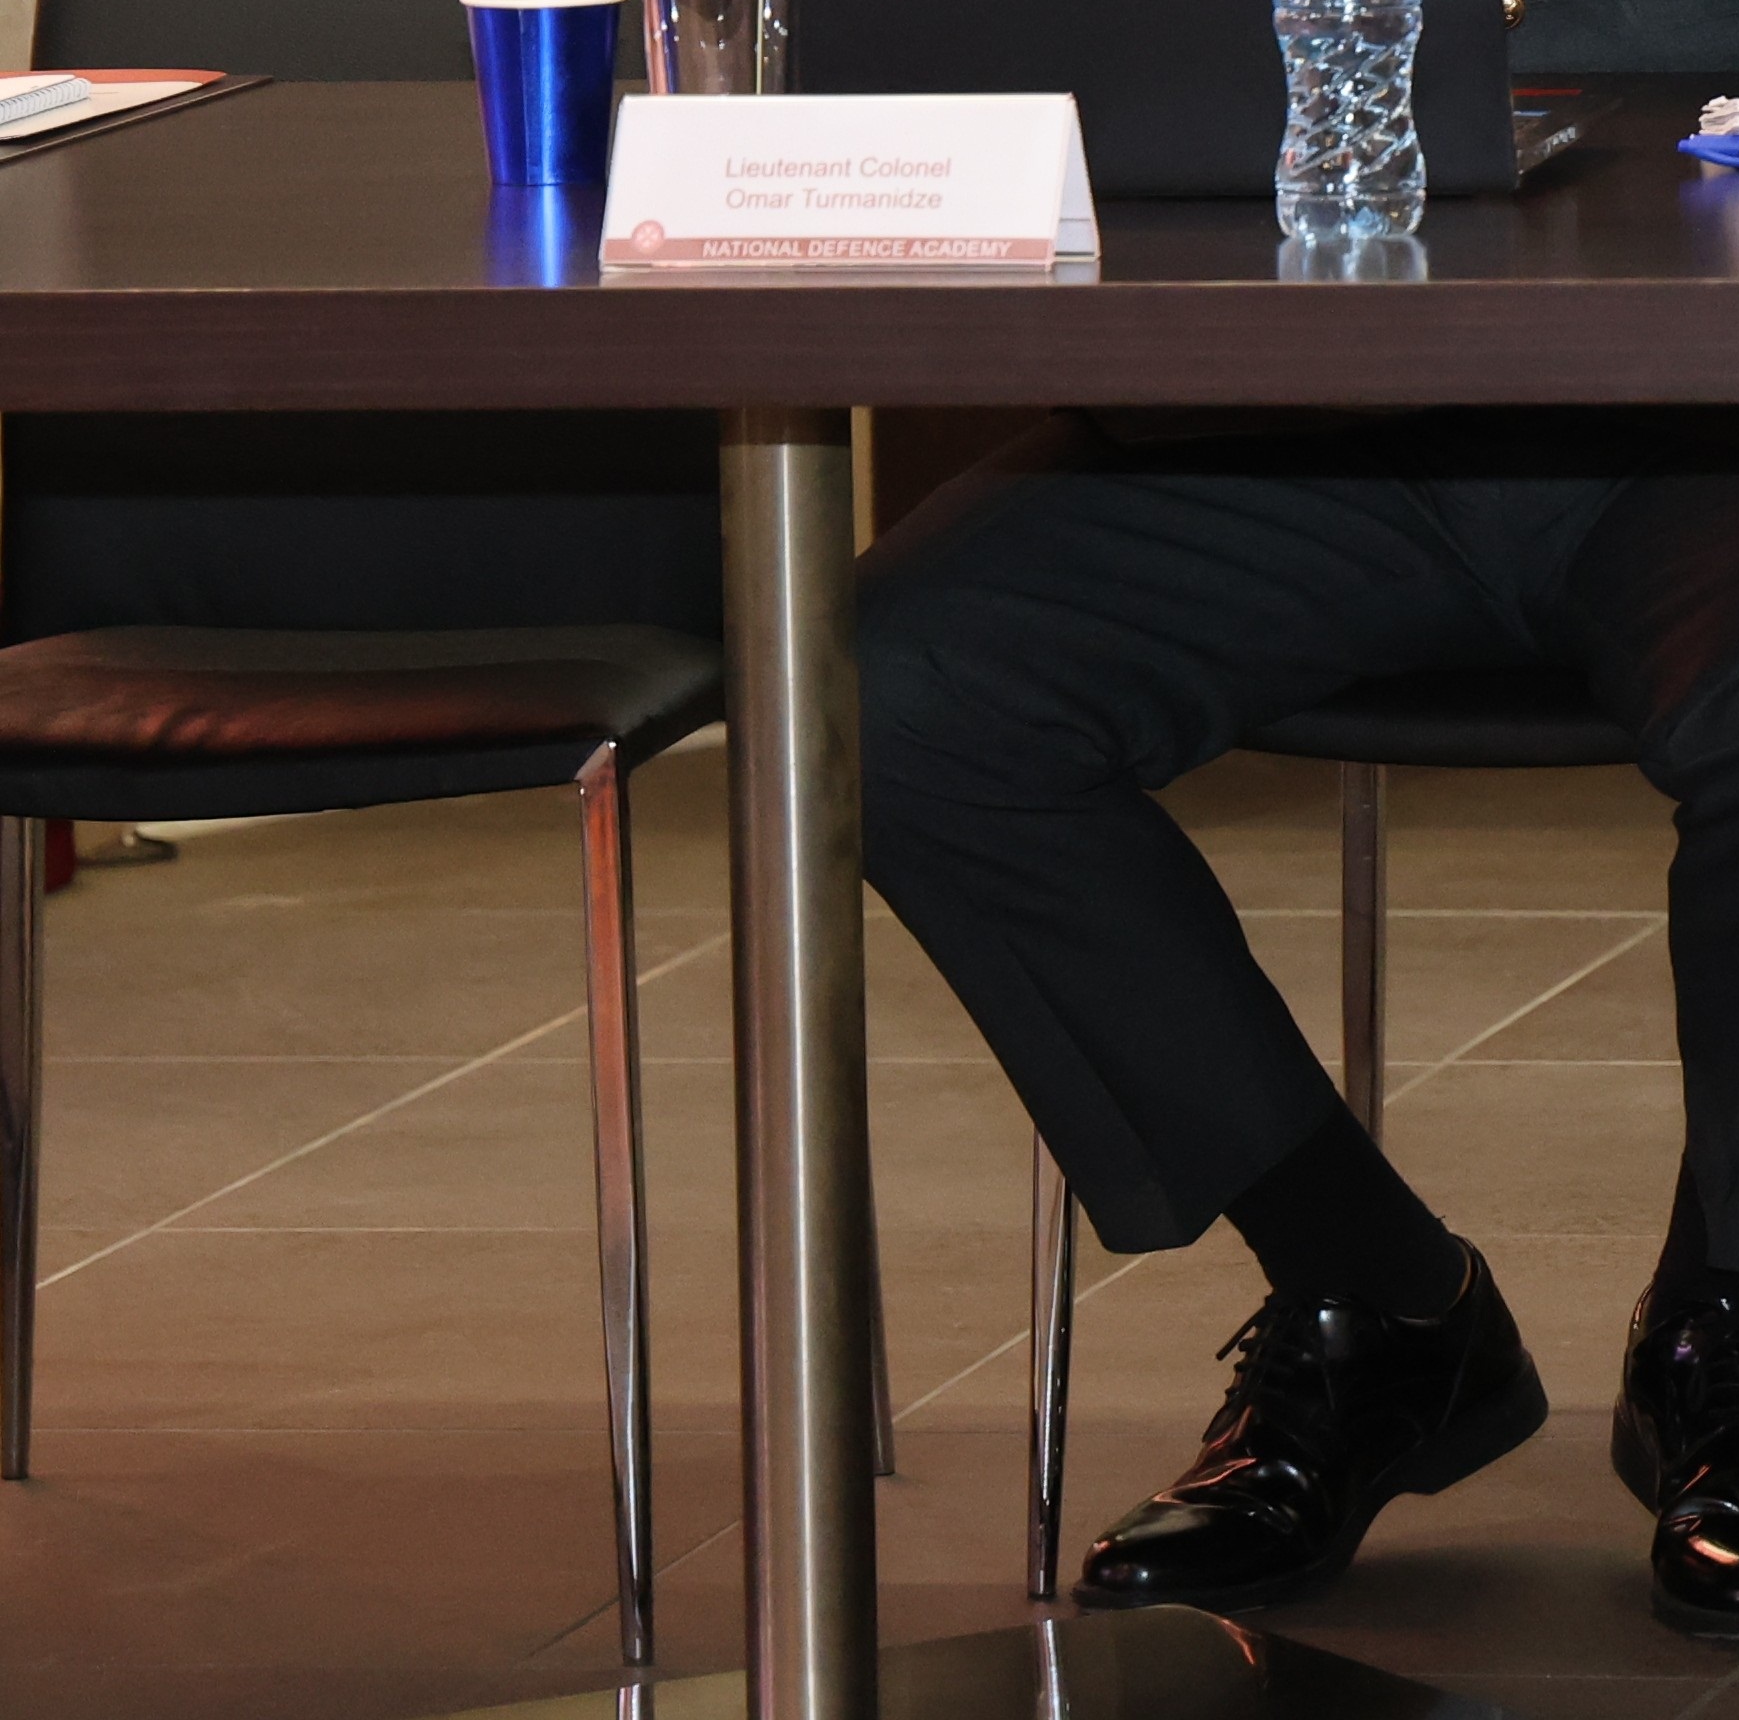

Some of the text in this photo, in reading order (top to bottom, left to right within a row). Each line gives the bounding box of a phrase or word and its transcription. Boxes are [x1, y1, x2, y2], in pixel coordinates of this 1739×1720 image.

[725, 157, 952, 178] Lieutenant Colonel
[725, 188, 943, 209] Omar Turmanidze
[703, 239, 1013, 258] NATIONAL DEFENCE ACADEMY
